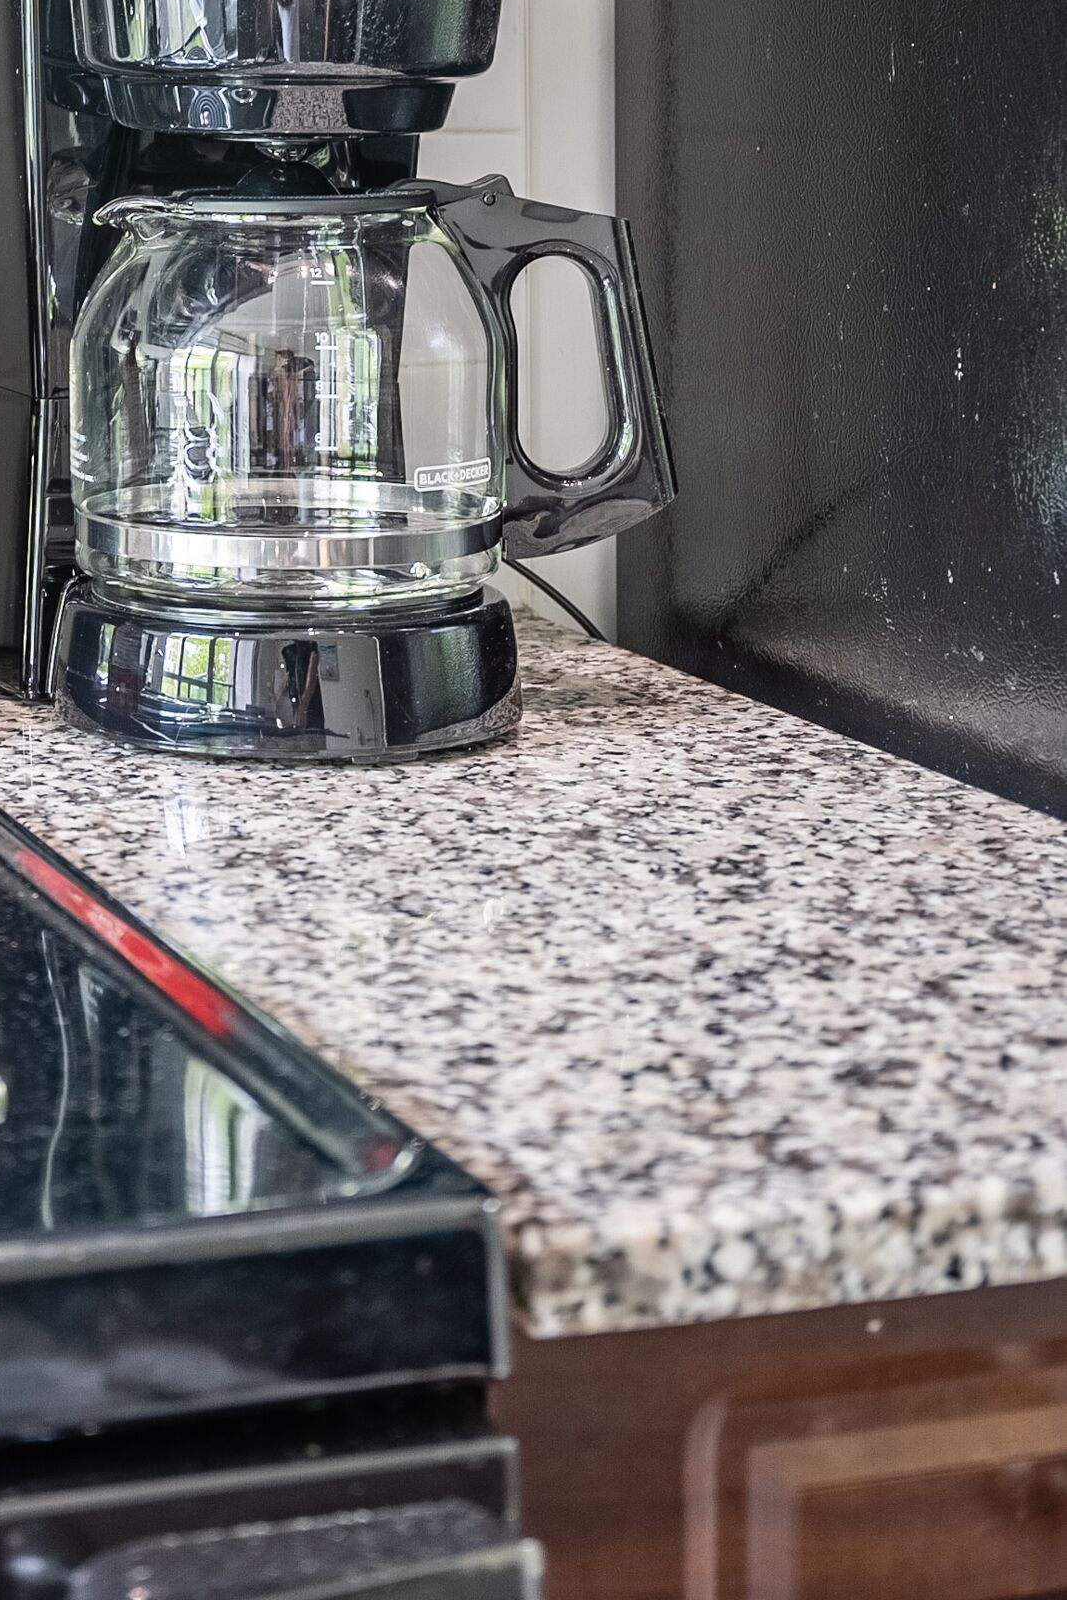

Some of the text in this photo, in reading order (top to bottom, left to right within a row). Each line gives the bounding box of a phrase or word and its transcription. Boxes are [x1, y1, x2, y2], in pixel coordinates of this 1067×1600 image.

[310, 267, 322, 278] 12
[315, 332, 329, 343] 10
[315, 380, 323, 390] 8
[419, 464, 488, 485] BLACK+DECKER
